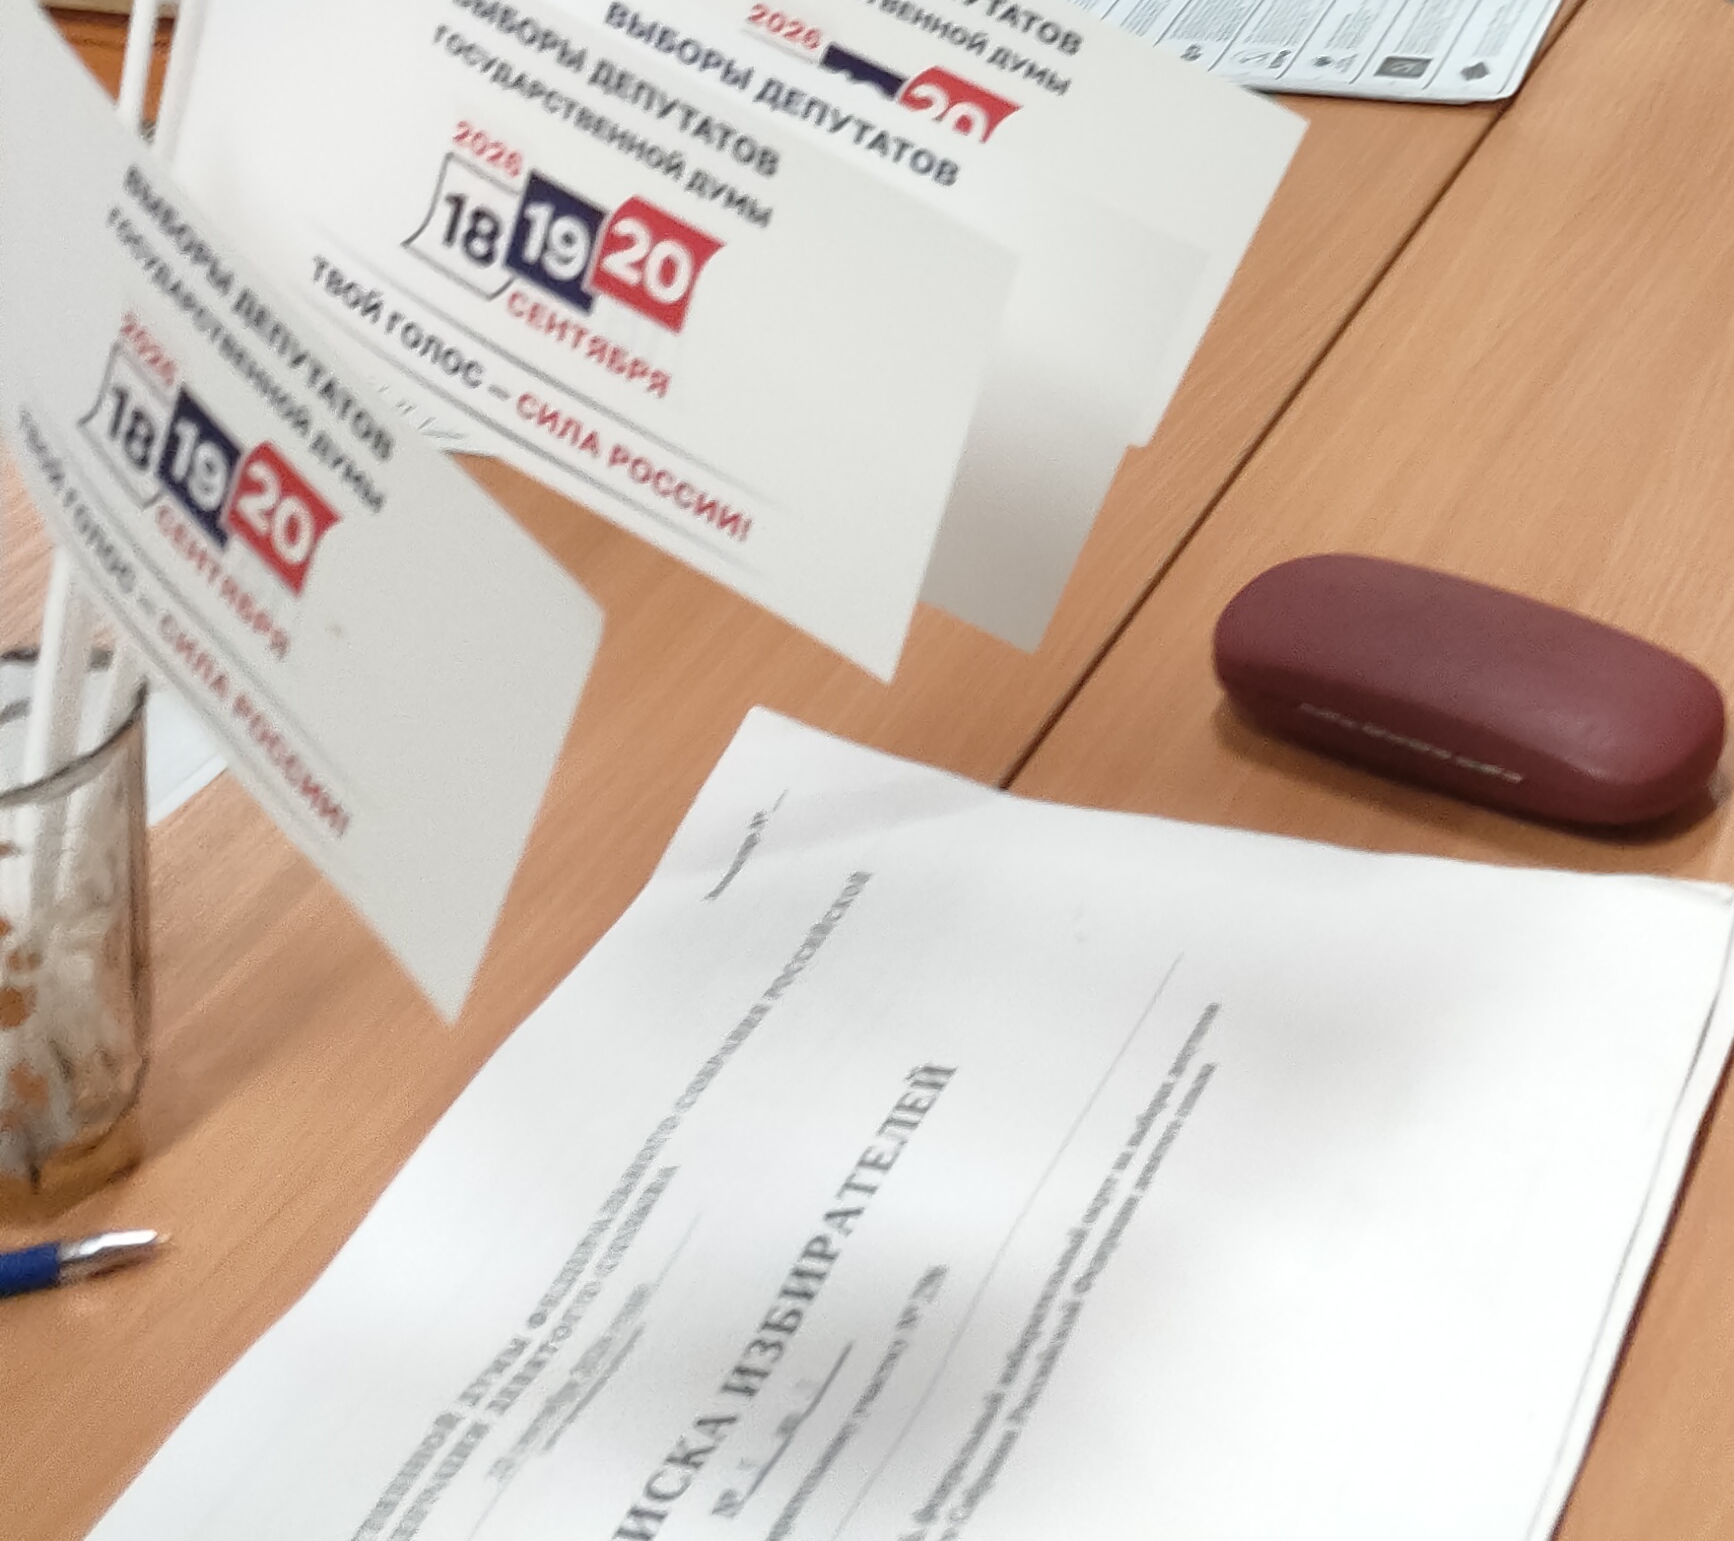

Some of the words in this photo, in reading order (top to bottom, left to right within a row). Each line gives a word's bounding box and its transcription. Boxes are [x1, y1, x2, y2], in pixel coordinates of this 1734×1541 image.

[432, 23, 688, 183] ГОСУДАРСТВЕННОЙ
[684, 169, 775, 229] ДУМЫ
[587, 57, 781, 178] ДЕПУТАТОВ
[603, 0, 755, 91] ВЫБОРЫ
[752, 76, 961, 187] ДЕПУТАТОВ
[986, 45, 1073, 98] ДУМЫ
[123, 164, 236, 298] ВЫБОРЫ
[231, 285, 396, 463] ДЕПУТАТОВ
[442, 192, 501, 268] 18
[520, 200, 591, 282] 19
[600, 217, 694, 306] 20
[312, 254, 385, 325] ТВОЙ
[384, 312, 486, 391] ГОЛОС
[515, 391, 601, 458] СИЛА
[606, 443, 755, 543] РОССИИ!
[506, 289, 673, 399] СЕНТЯБРЯ
[107, 385, 156, 473] 18
[169, 420, 229, 513] 19
[236, 461, 316, 565] 20
[308, 428, 388, 514] ДУМЫ
[154, 504, 291, 661] СЕНТЯБРЯ
[719, 1062, 960, 1400] ИЗБИРАТЕЛЕЙ
